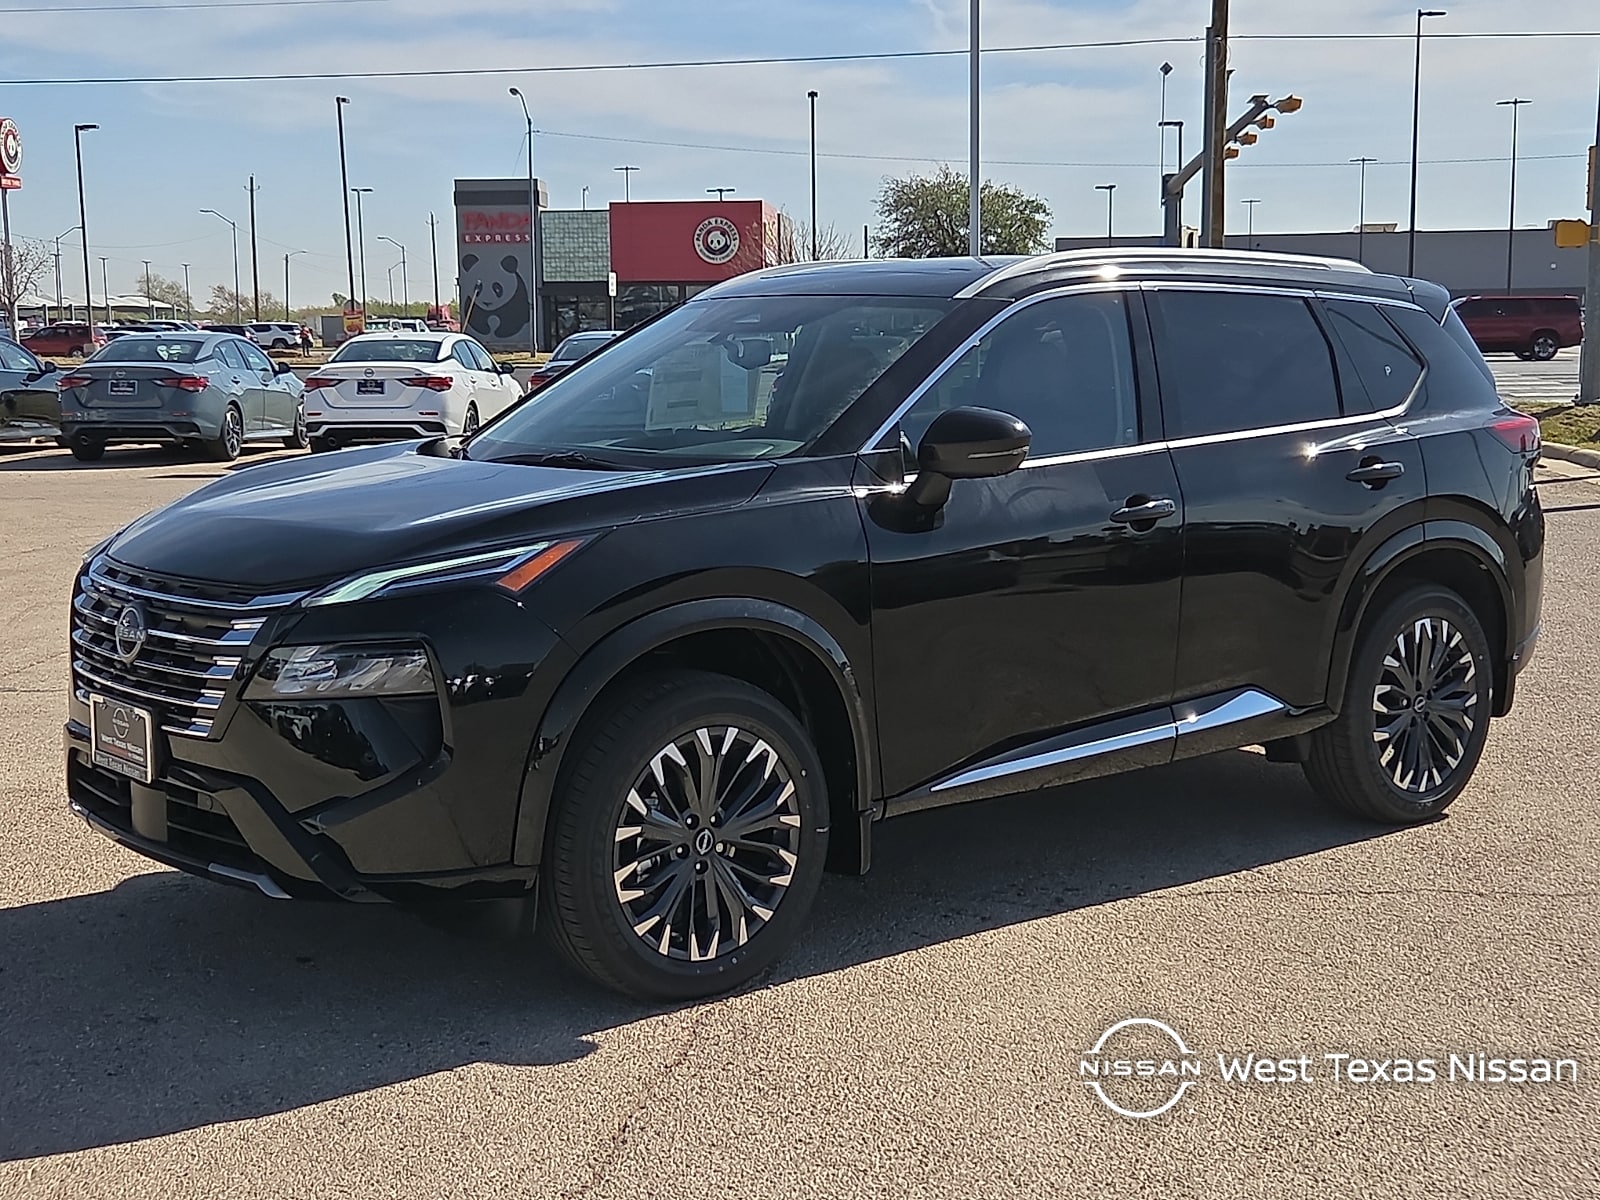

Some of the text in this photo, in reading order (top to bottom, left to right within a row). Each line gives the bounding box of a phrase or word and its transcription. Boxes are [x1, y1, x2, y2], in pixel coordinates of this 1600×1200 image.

[463, 213, 531, 230] PANDA
[695, 218, 738, 242] PANDA EXPRESS
[465, 234, 531, 242] EXPRESS
[117, 627, 145, 641] SSAN
